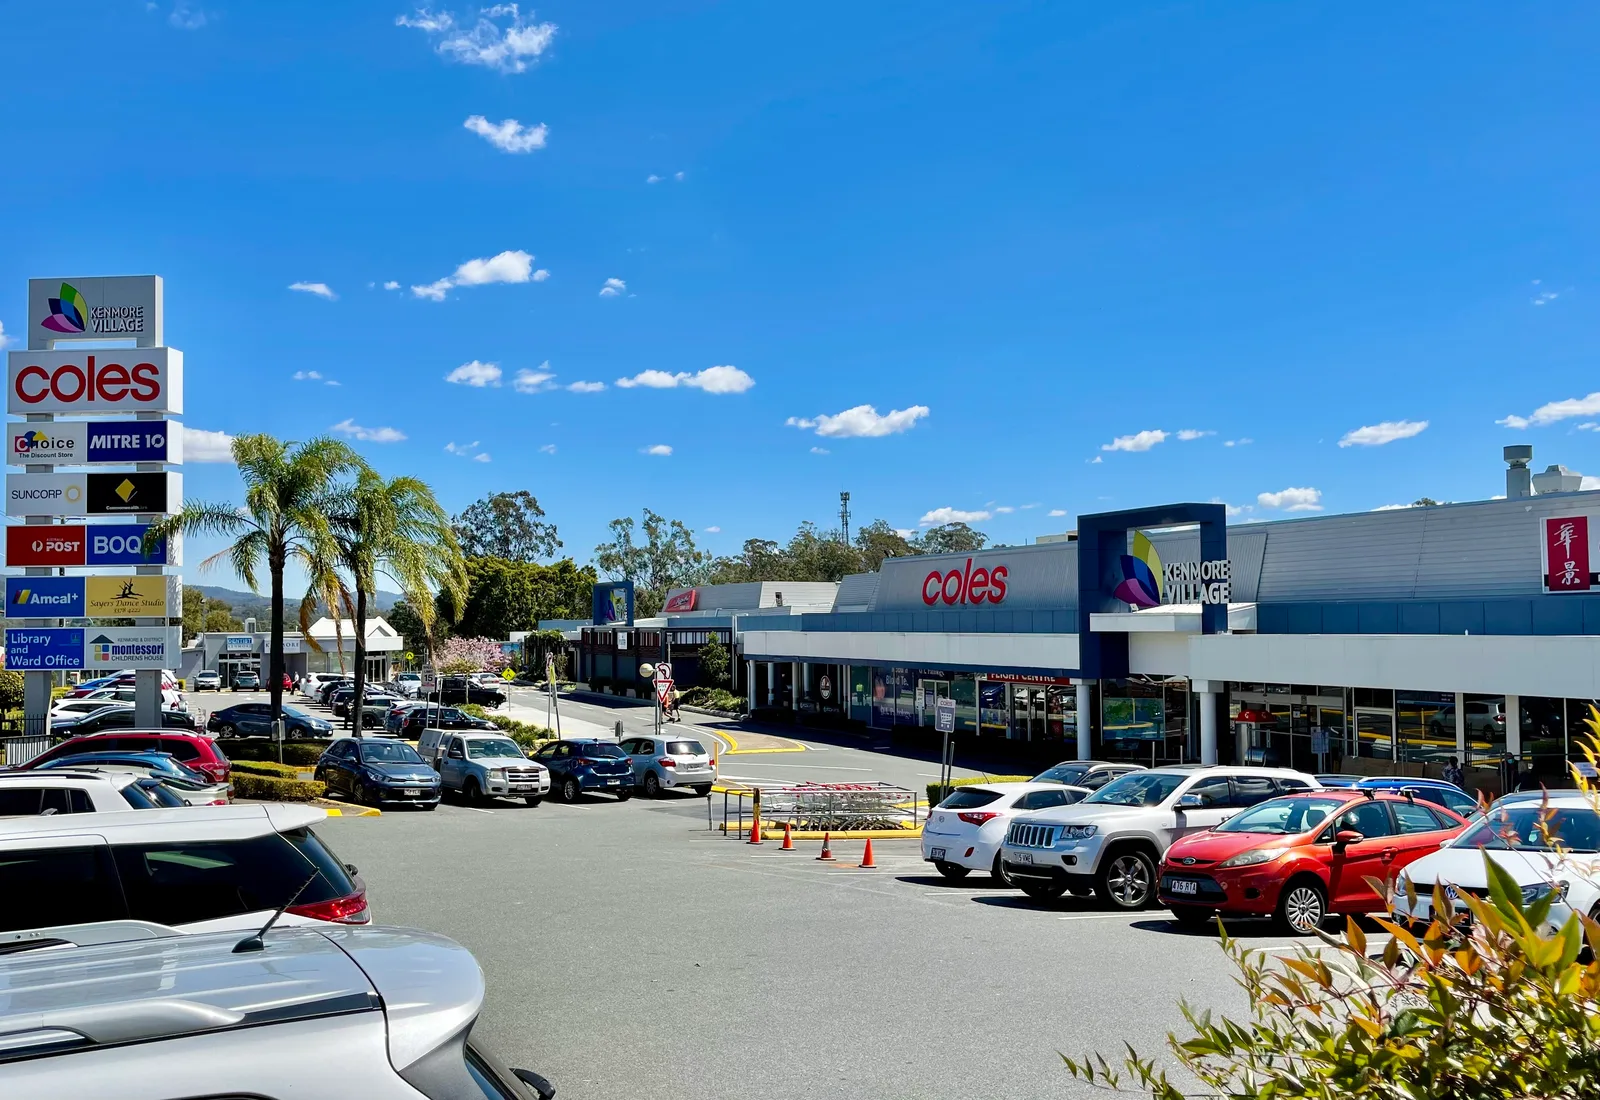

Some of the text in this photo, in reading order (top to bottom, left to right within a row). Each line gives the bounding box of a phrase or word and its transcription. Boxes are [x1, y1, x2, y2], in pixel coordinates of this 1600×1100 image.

[91, 306, 143, 318] KENMORE
[91, 318, 143, 332] VILLAGE
[15, 355, 161, 404] coles
[90, 433, 165, 449] MITRE 10
[11, 489, 62, 500] SUNCORP
[46, 541, 80, 552] POST
[94, 535, 142, 555] BOQ
[1164, 559, 1230, 581] KENMORE
[922, 558, 1009, 607] coles
[1165, 582, 1231, 605] VILLAGE
[90, 598, 165, 610] Sayers Dance Studio
[11, 633, 51, 647] Library
[11, 645, 29, 654] and
[111, 643, 164, 655] montessori
[10, 655, 80, 667] Ward Office
[424, 674, 433, 682] 15
